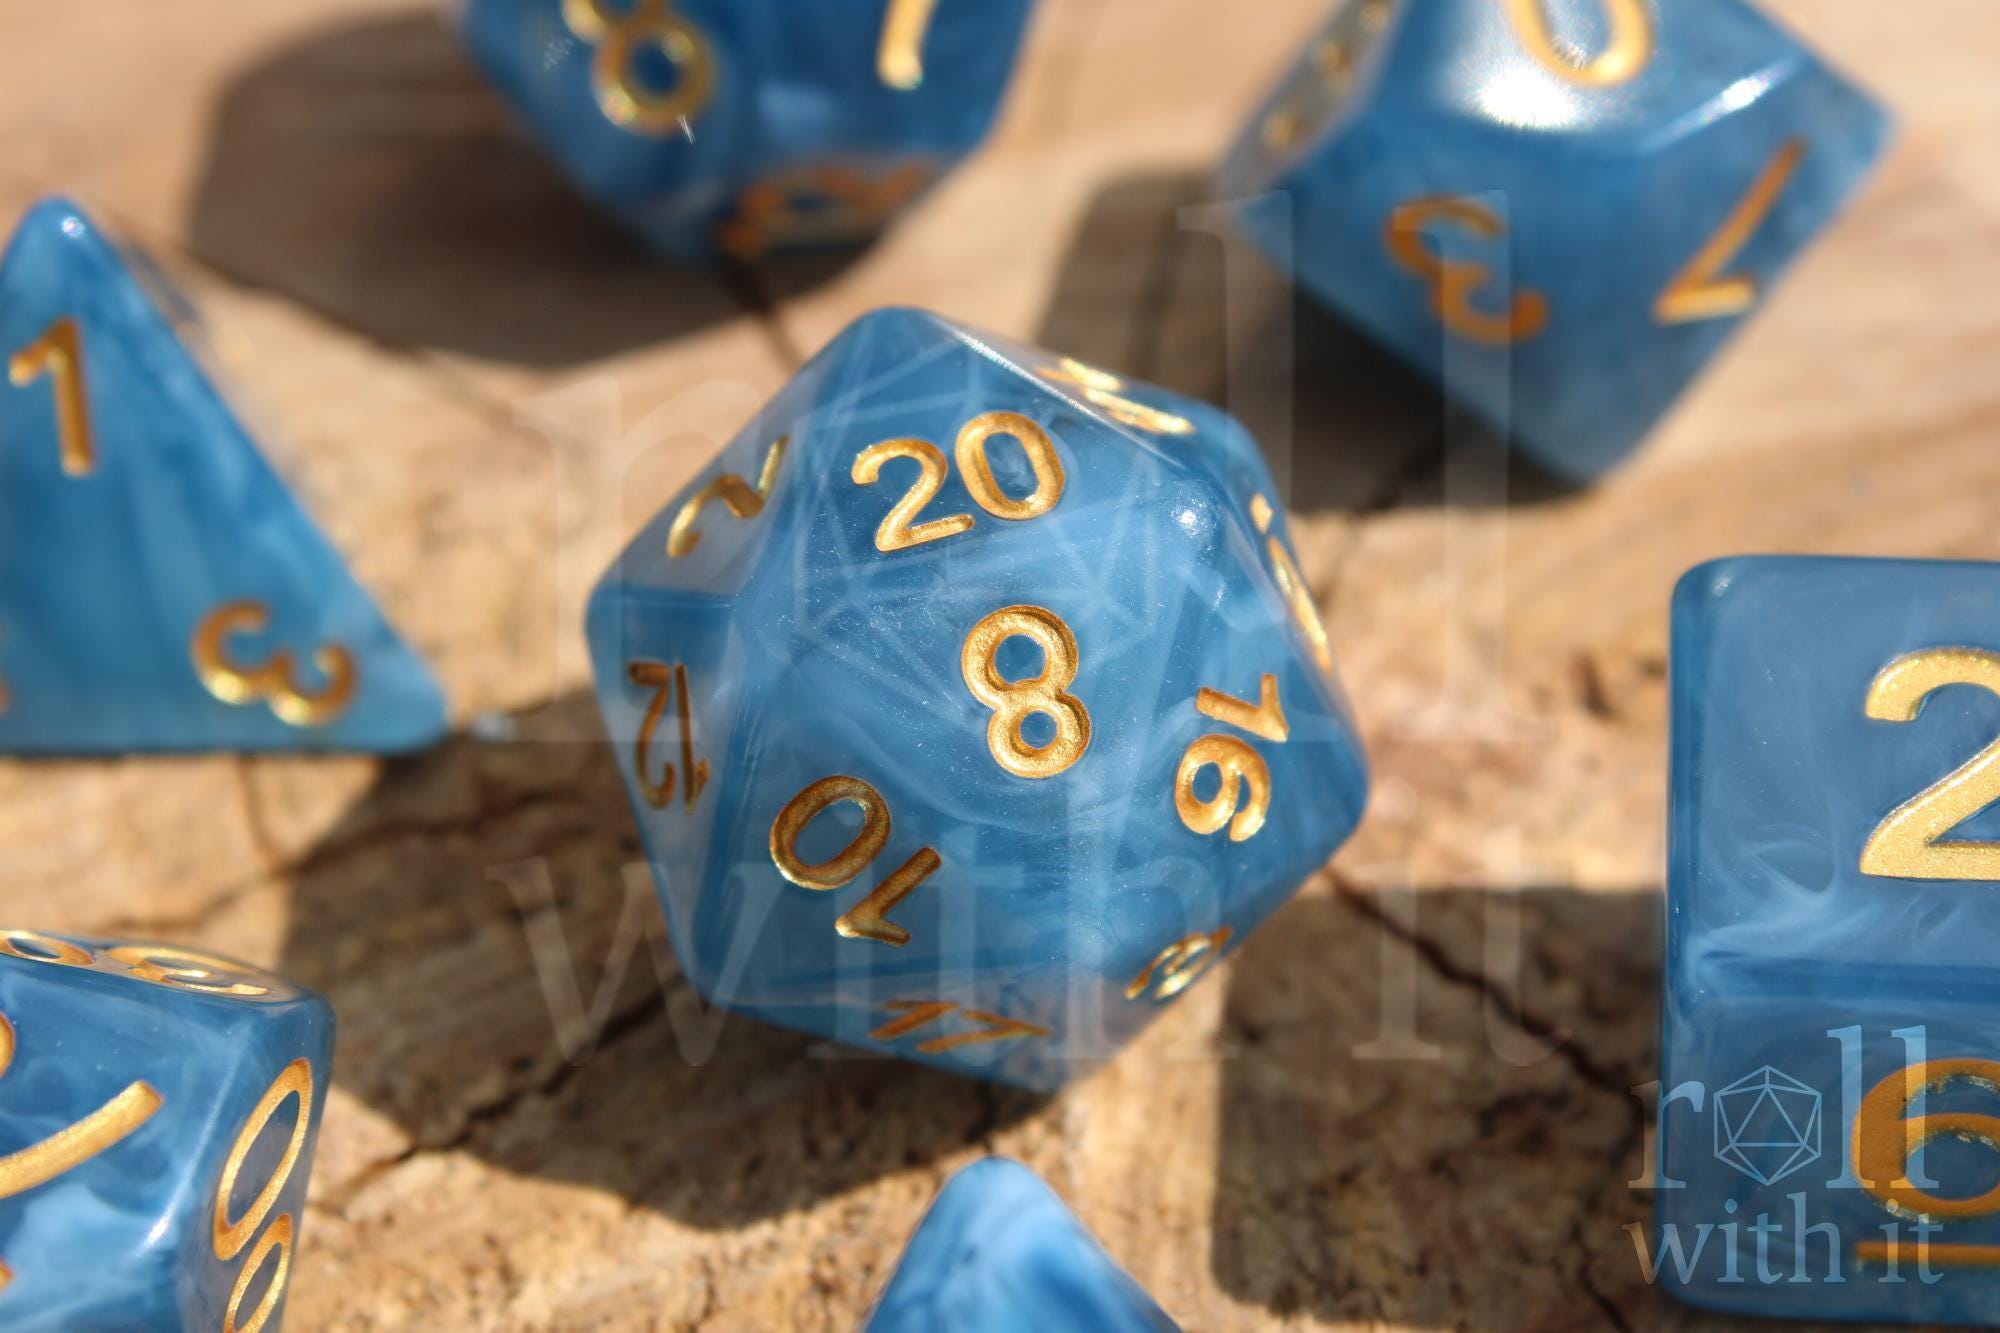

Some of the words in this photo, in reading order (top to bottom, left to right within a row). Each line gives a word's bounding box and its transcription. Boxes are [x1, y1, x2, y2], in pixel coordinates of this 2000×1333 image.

[1386, 194, 1548, 343] 3
[9, 316, 95, 478] 1
[852, 411, 1066, 553] 20
[190, 600, 359, 727] 3
[628, 662, 711, 815] 12
[961, 605, 1091, 779] 8
[1174, 673, 1290, 842] 16
[1860, 646, 2000, 881] 2
[769, 774, 942, 946] 10
